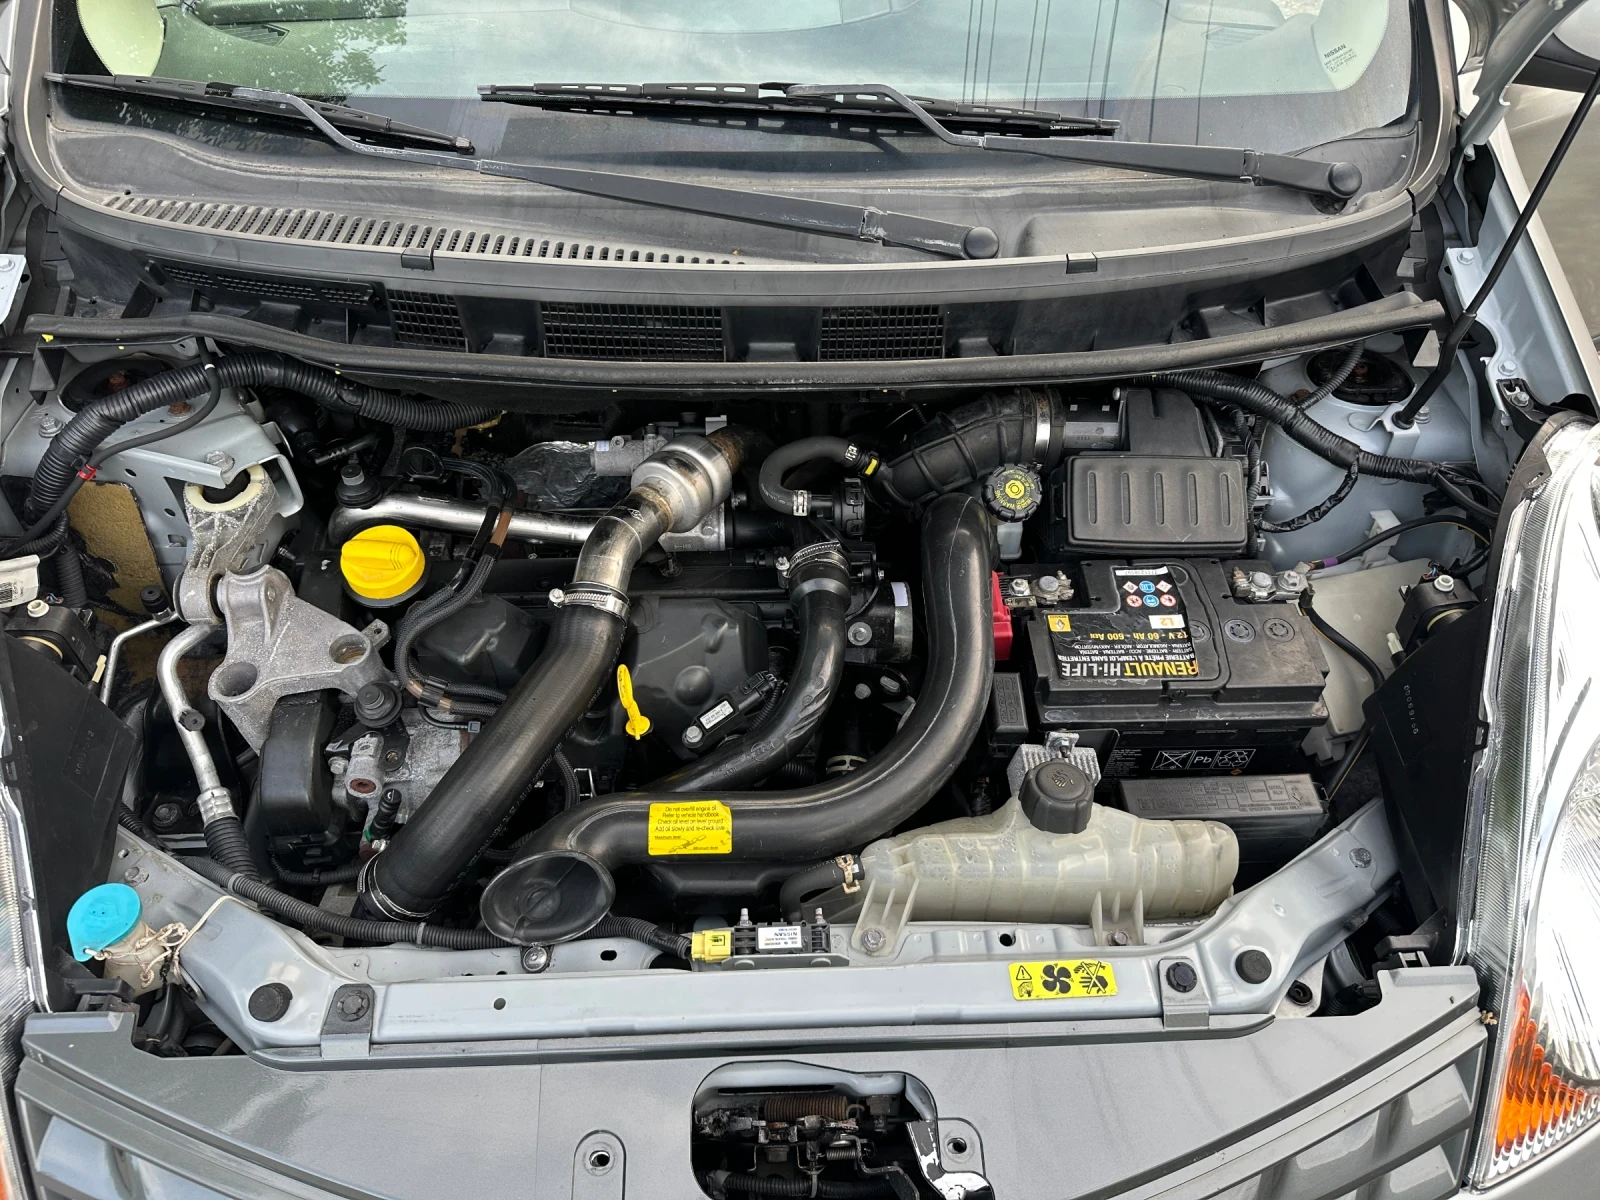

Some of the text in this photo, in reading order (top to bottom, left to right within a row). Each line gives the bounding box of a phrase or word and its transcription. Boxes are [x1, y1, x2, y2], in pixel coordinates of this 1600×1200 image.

[1324, 44, 1346, 59] NISSAN
[994, 489, 1015, 510] WARNING
[1160, 617, 1174, 627] L2
[1133, 632, 1145, 640] Ah
[1147, 632, 1159, 640] 60
[1177, 631, 1188, 639] 12
[1164, 653, 1194, 661] BATTERIE
[1123, 660, 1199, 677] RENAULT
[1193, 756, 1212, 764] Pb
[707, 817, 724, 825] ground
